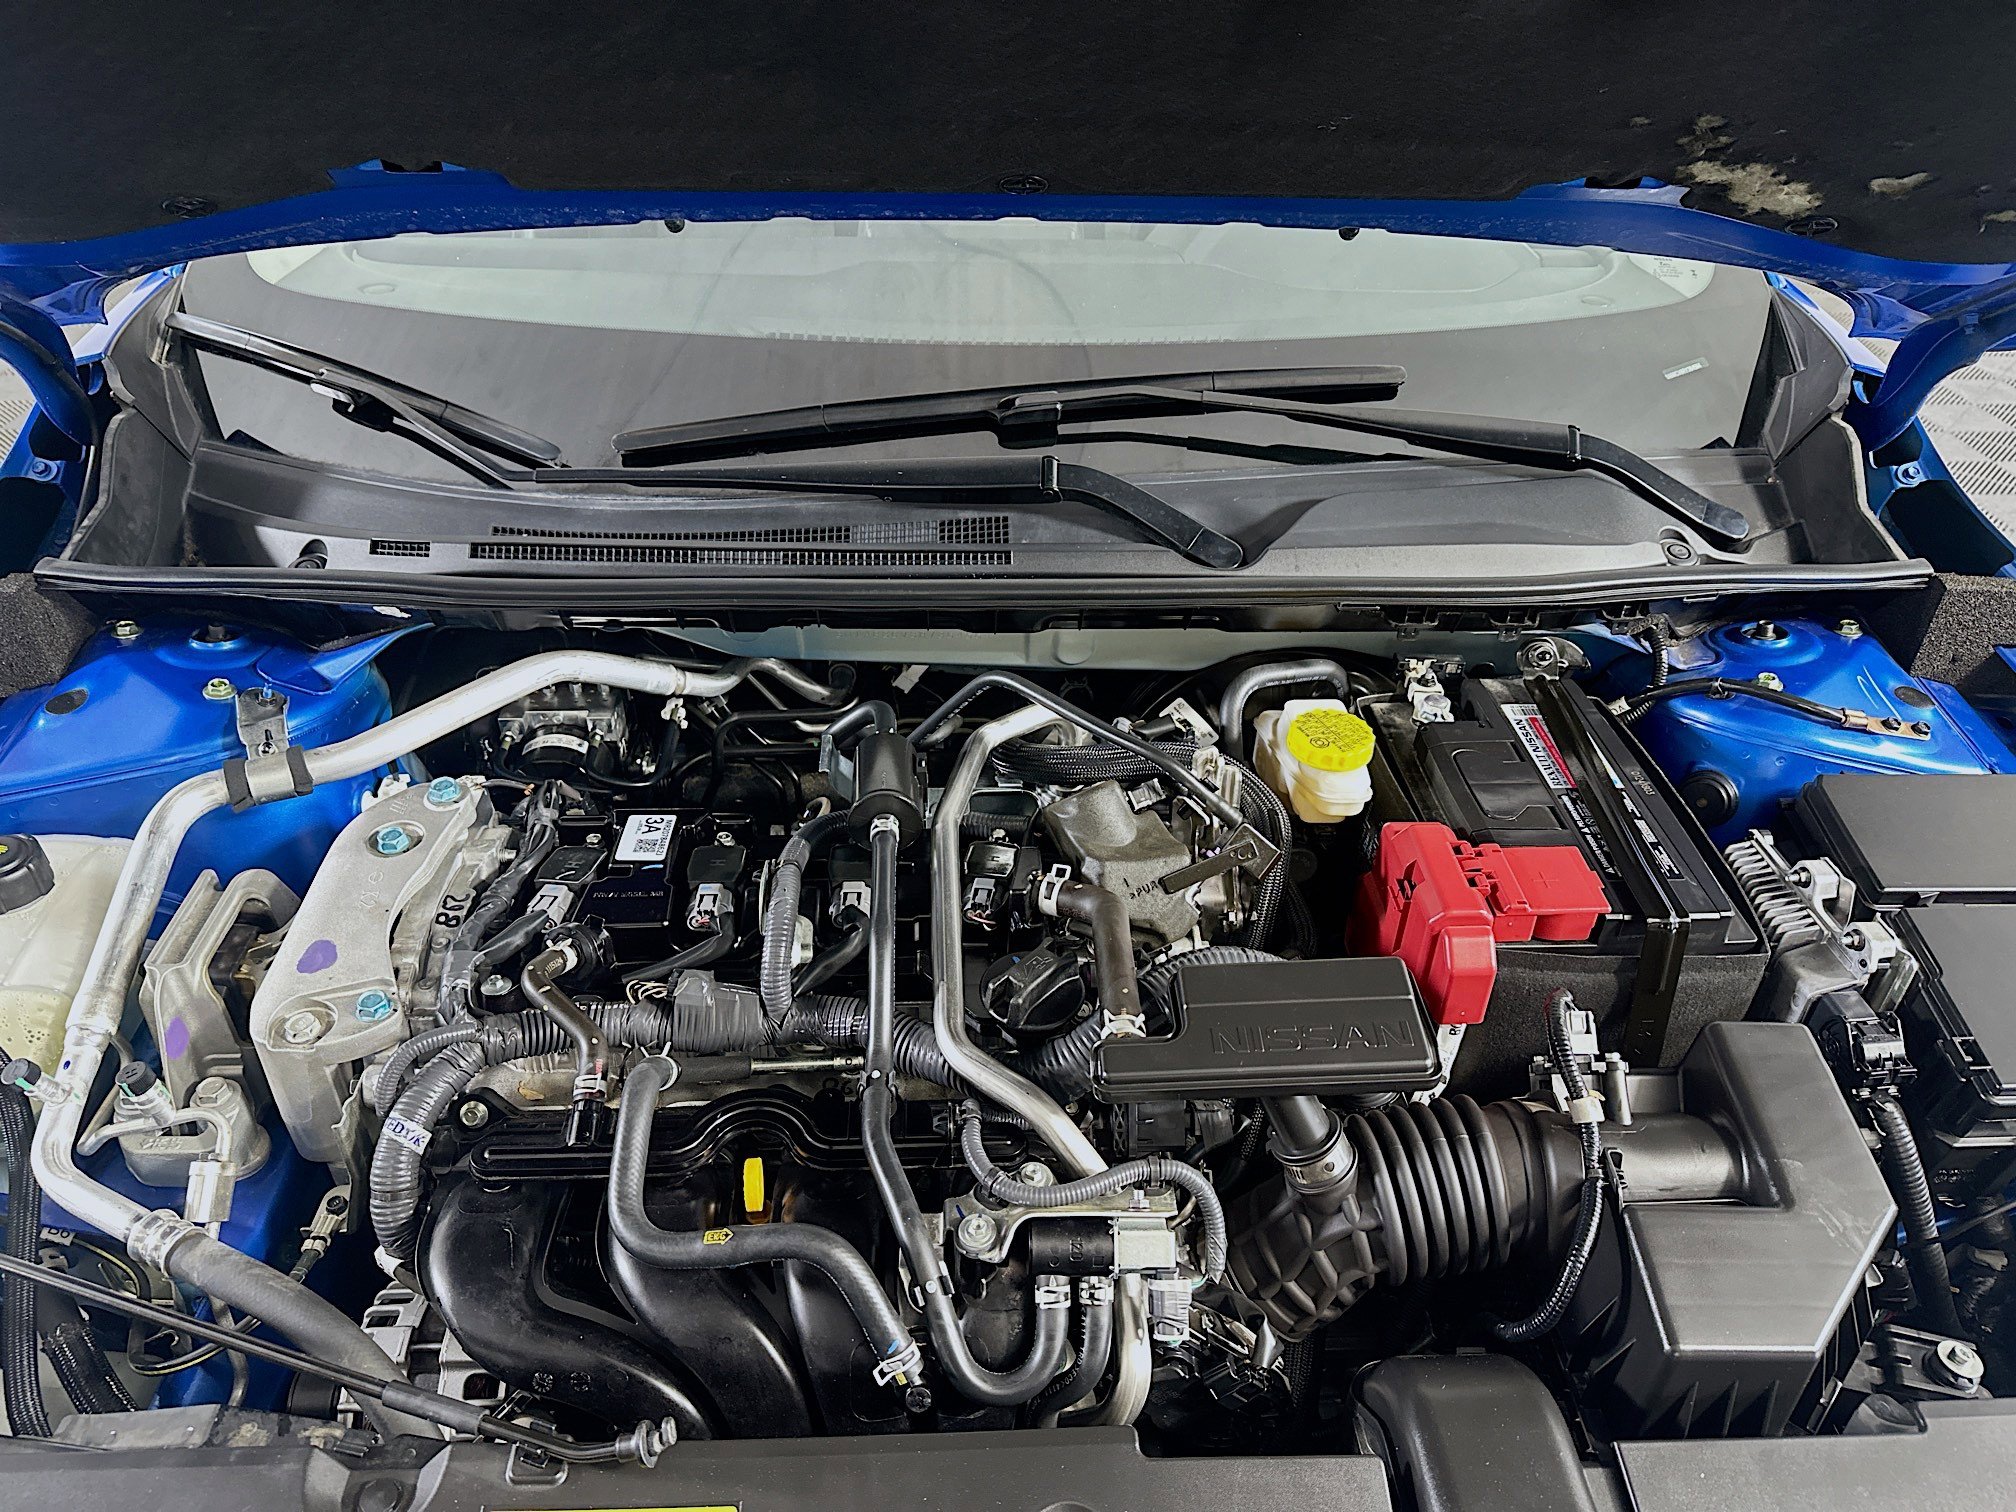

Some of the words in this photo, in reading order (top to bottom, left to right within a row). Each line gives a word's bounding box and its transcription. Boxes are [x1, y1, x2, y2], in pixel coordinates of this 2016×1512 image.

[1514, 718, 1541, 753] NISSAN
[641, 817, 665, 835] 3A
[1209, 1019, 1415, 1055] NISSAN
